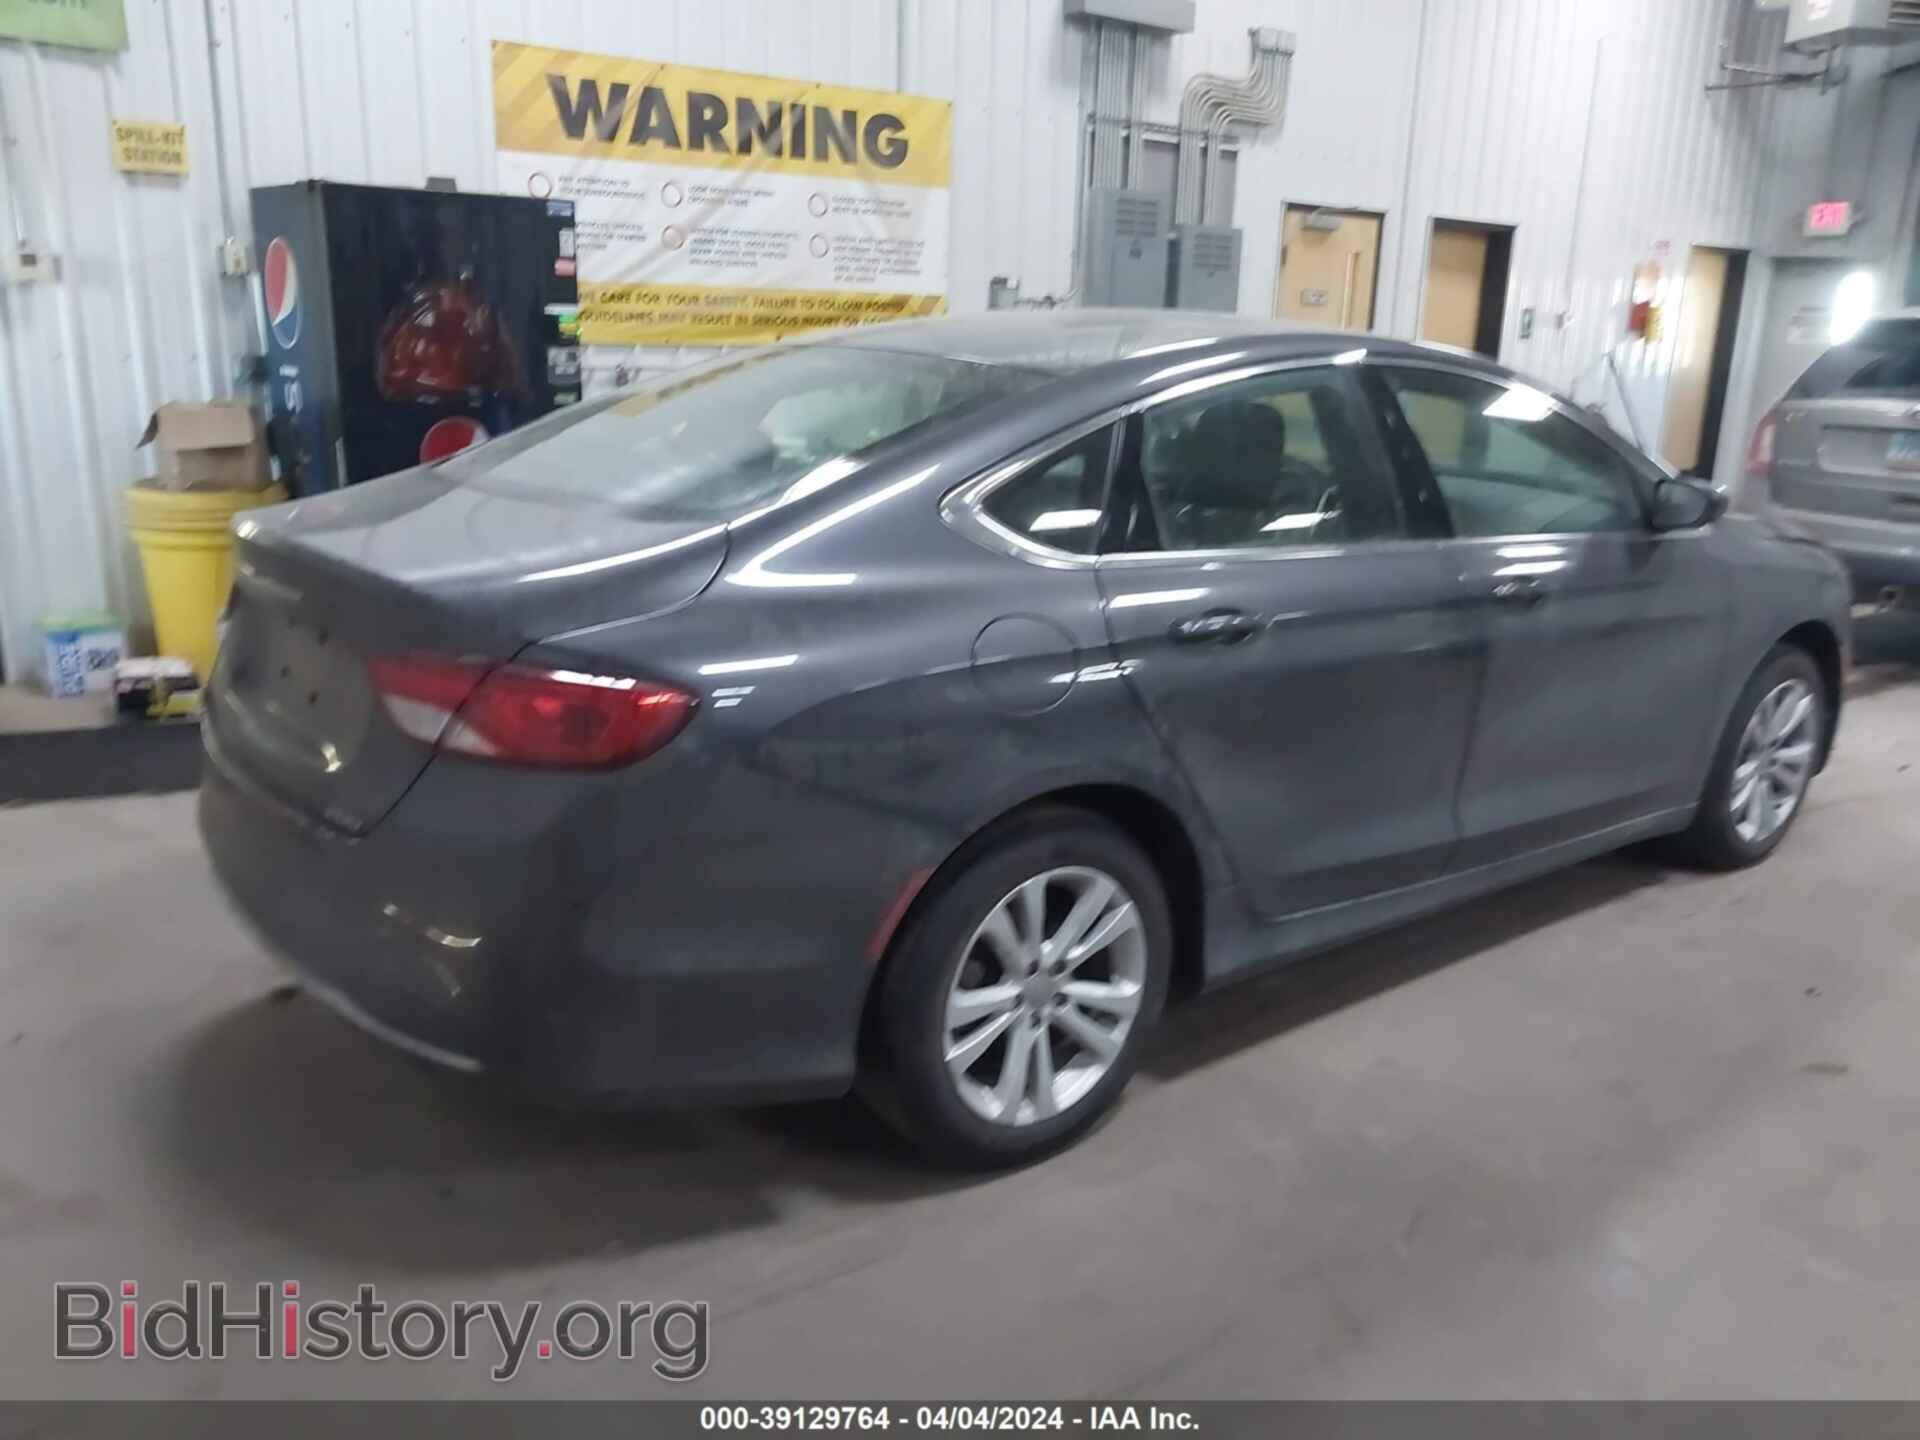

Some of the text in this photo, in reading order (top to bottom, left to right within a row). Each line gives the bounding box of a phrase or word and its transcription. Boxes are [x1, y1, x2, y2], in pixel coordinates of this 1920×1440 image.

[547, 74, 908, 170] WARNING
[121, 147, 183, 165] STATION
[600, 290, 633, 304] CARE
[636, 292, 660, 304] FOR
[666, 293, 699, 305] YOUR
[752, 296, 798, 310] FAILURE
[801, 297, 816, 310] TO
[818, 298, 863, 312] FOLLOW
[691, 312, 732, 326] RESULT
[752, 314, 800, 328] SERIOUS
